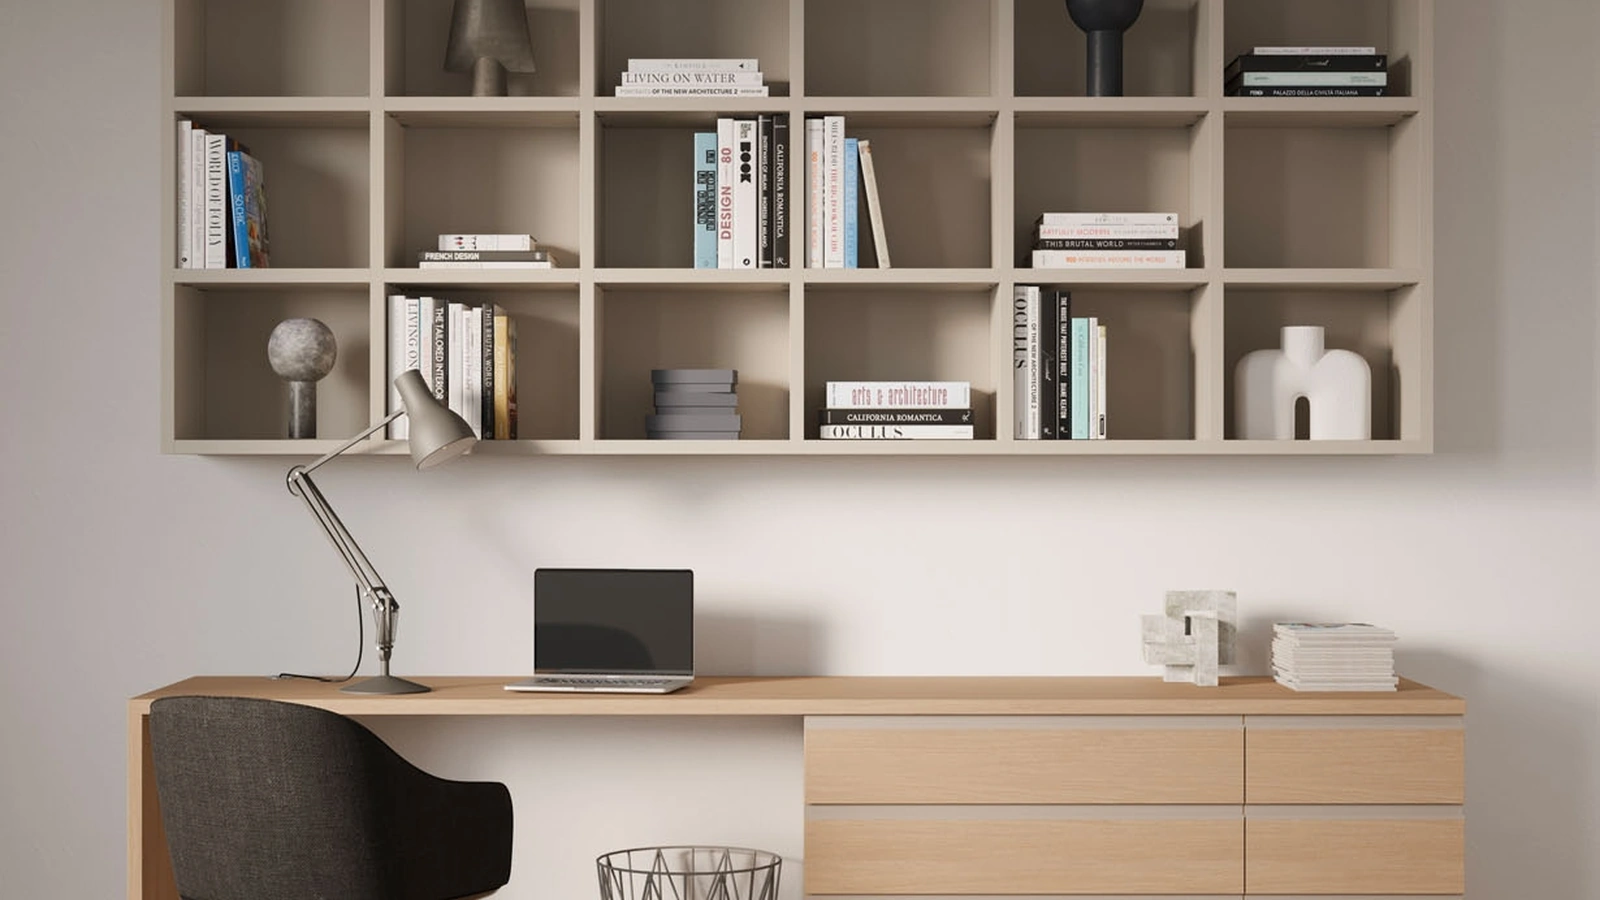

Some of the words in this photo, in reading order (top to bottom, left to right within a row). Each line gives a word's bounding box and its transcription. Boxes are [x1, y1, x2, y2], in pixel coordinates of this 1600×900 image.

[626, 73, 669, 83] LIVING
[673, 73, 690, 83] ON
[694, 73, 736, 83] WATER
[208, 139, 222, 186] WORLD
[720, 148, 731, 164] 80
[740, 142, 751, 183] BOOK
[776, 144, 784, 191] CALIFORNIA
[208, 188, 222, 203] OF
[720, 186, 731, 239] DESIGN
[776, 193, 784, 238] ROMANTICA
[208, 208, 222, 245] FOLLY
[1045, 240, 1063, 248] THIS
[1065, 240, 1094, 248] BRUTAL
[1096, 240, 1124, 248] WORLD
[425, 252, 453, 261] FRENCH
[454, 252, 480, 261] DESIGN
[407, 303, 418, 347] LIVING
[434, 307, 444, 323] THE
[1014, 298, 1027, 369] OCULUS
[1031, 323, 1037, 331] OF
[434, 324, 444, 361] TAILORED
[1059, 336, 1067, 361] PINTEREST
[407, 350, 418, 368] ON
[434, 363, 444, 399] INTERIOR
[852, 385, 871, 405] arts
[888, 385, 948, 405] architecture
[847, 413, 895, 422] CALIFORNIA
[896, 413, 943, 422] ROMANTICA
[832, 425, 903, 439] OCULUS
